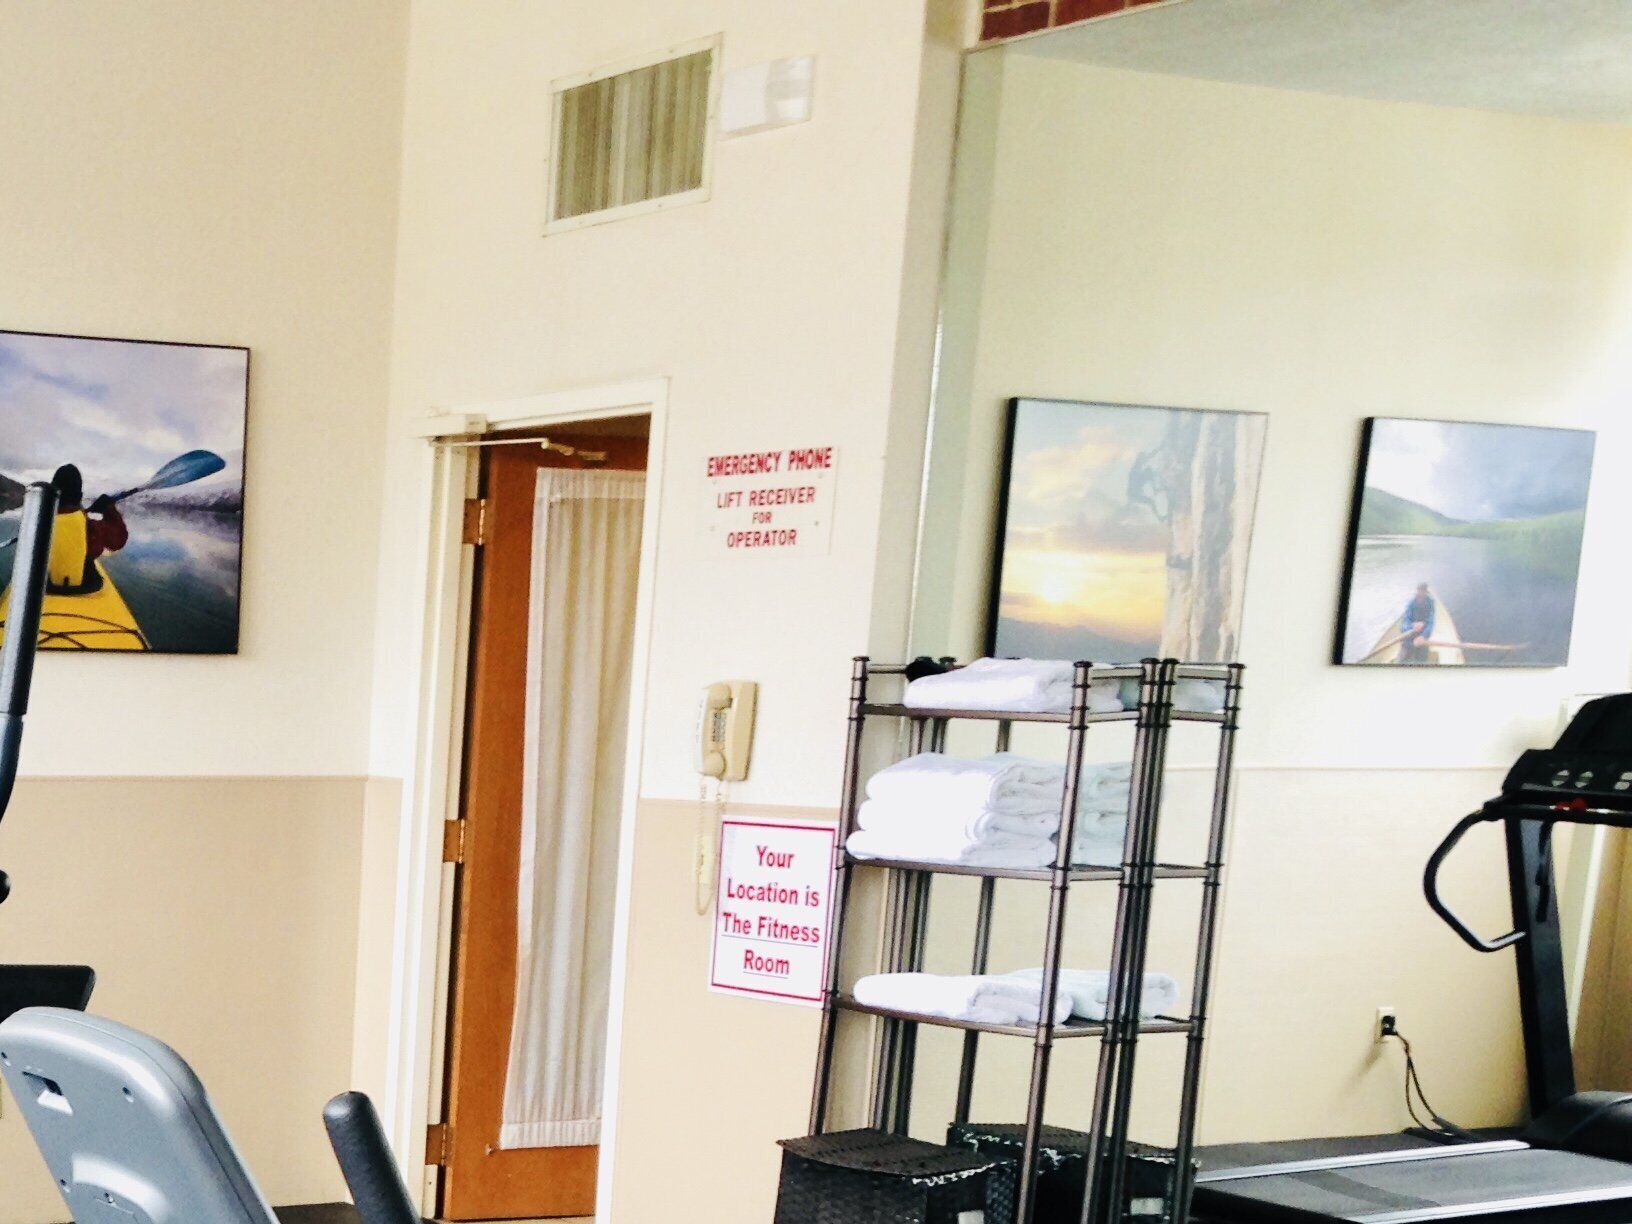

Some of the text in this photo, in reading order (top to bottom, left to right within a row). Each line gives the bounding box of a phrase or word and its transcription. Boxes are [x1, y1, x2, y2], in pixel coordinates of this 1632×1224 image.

[707, 447, 832, 477] EMERGENCY PHONE
[717, 486, 816, 508] LIFT RECEIVER
[752, 511, 773, 524] FOR
[727, 529, 797, 547] OPERATOR
[756, 845, 794, 868] Your
[726, 878, 820, 907] Location is
[723, 912, 820, 943] The Fitness
[744, 949, 790, 975] Room
